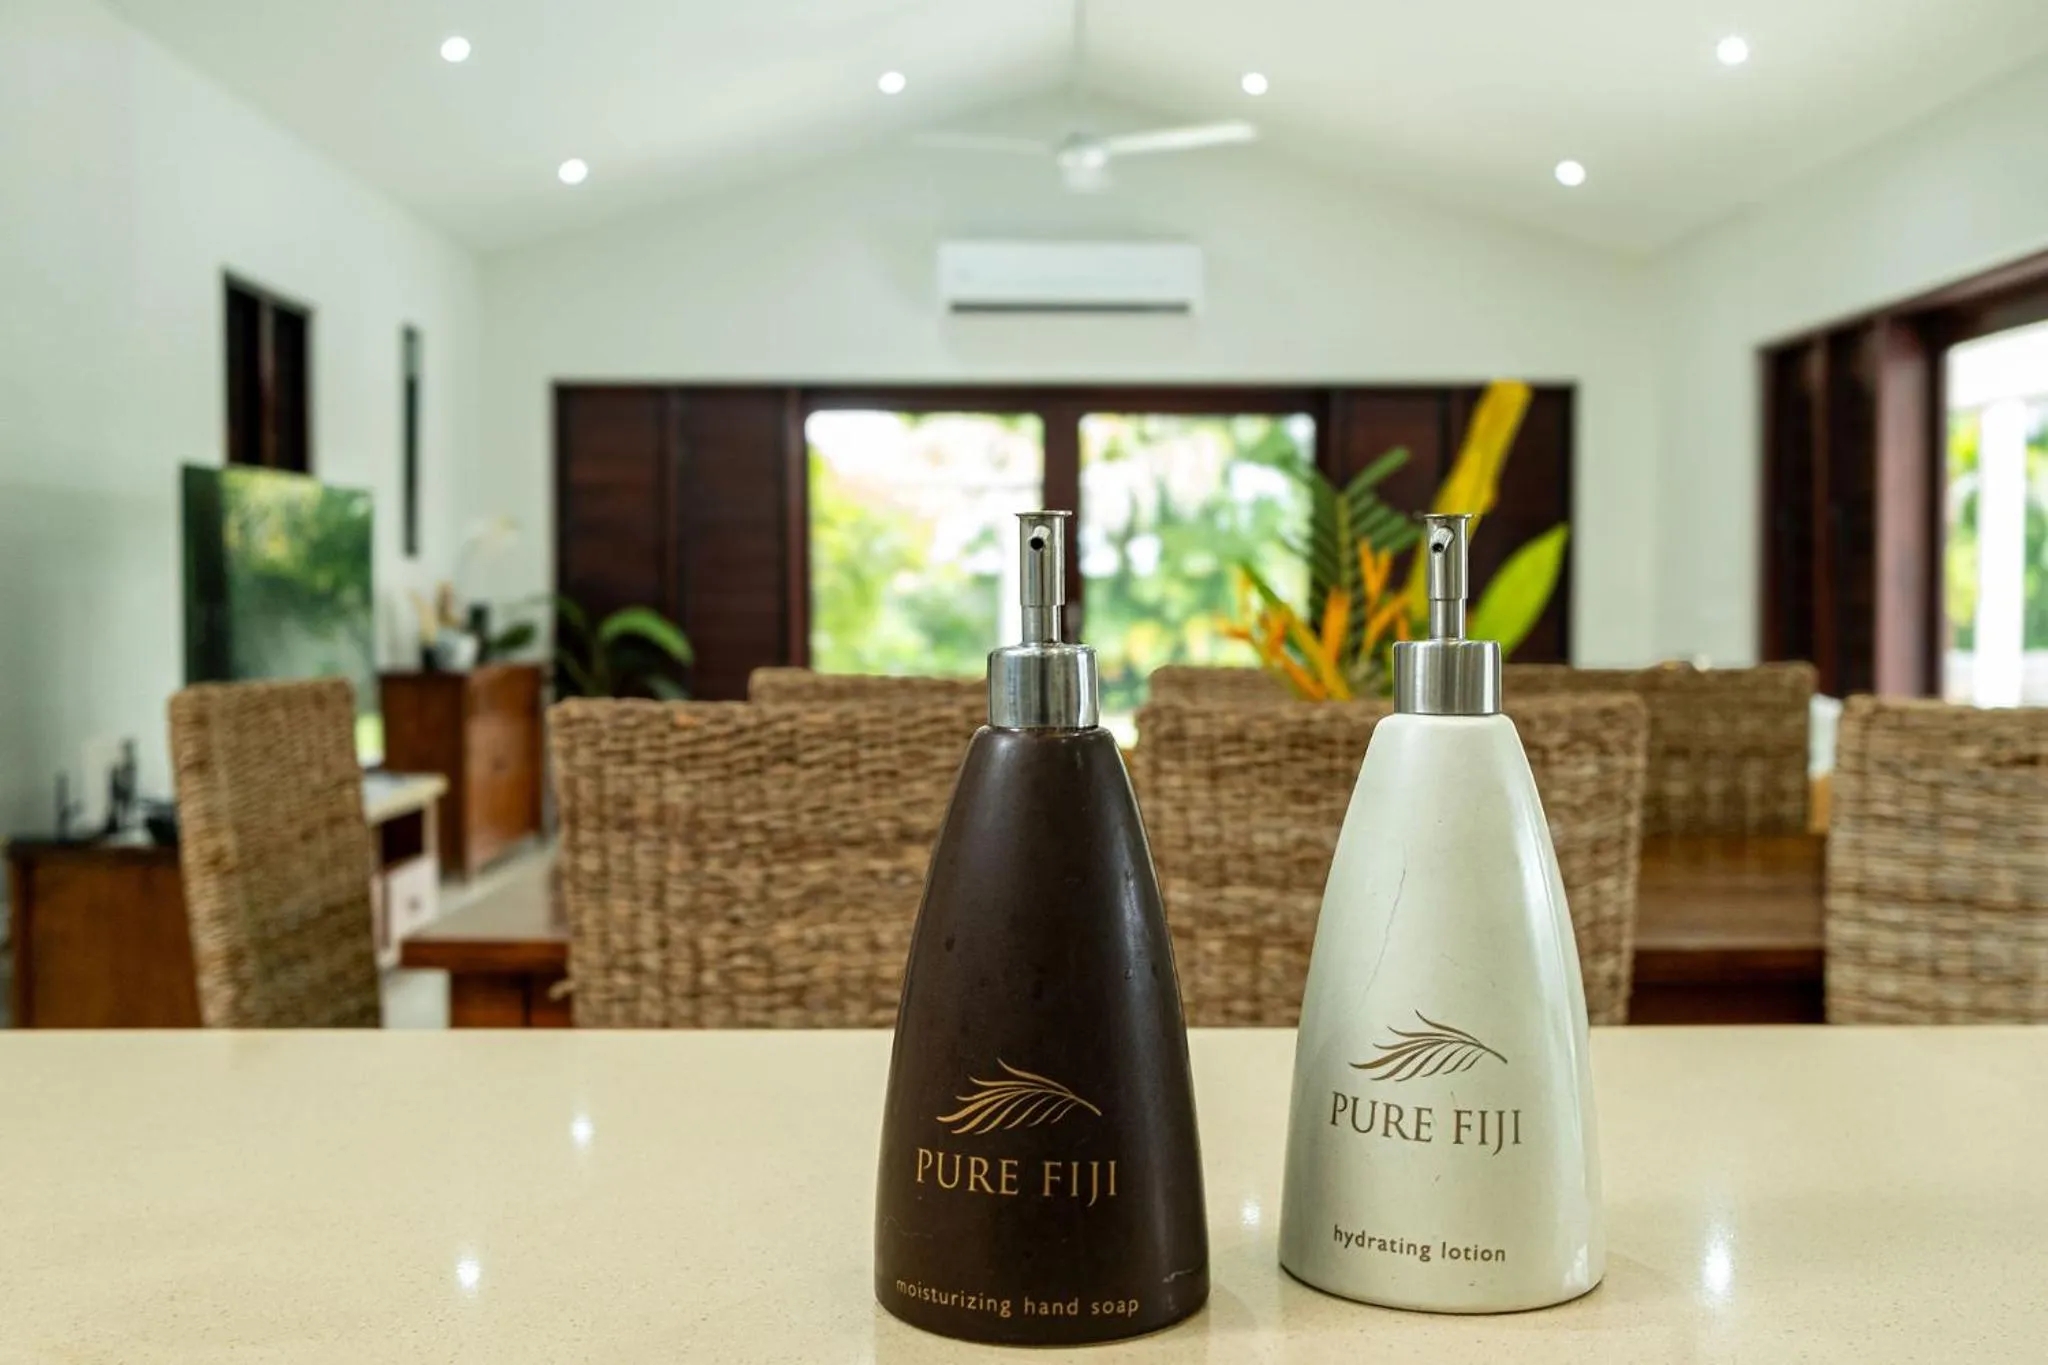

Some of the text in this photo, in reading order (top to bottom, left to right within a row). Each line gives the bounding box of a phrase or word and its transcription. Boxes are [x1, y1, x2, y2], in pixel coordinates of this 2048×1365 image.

[1329, 1090, 1522, 1156] PURE FIJI
[916, 1147, 1118, 1208] PURE FIJI
[1333, 1224, 1507, 1263] hydrating lotion
[895, 1278, 1140, 1318] moisturizing hand soap
